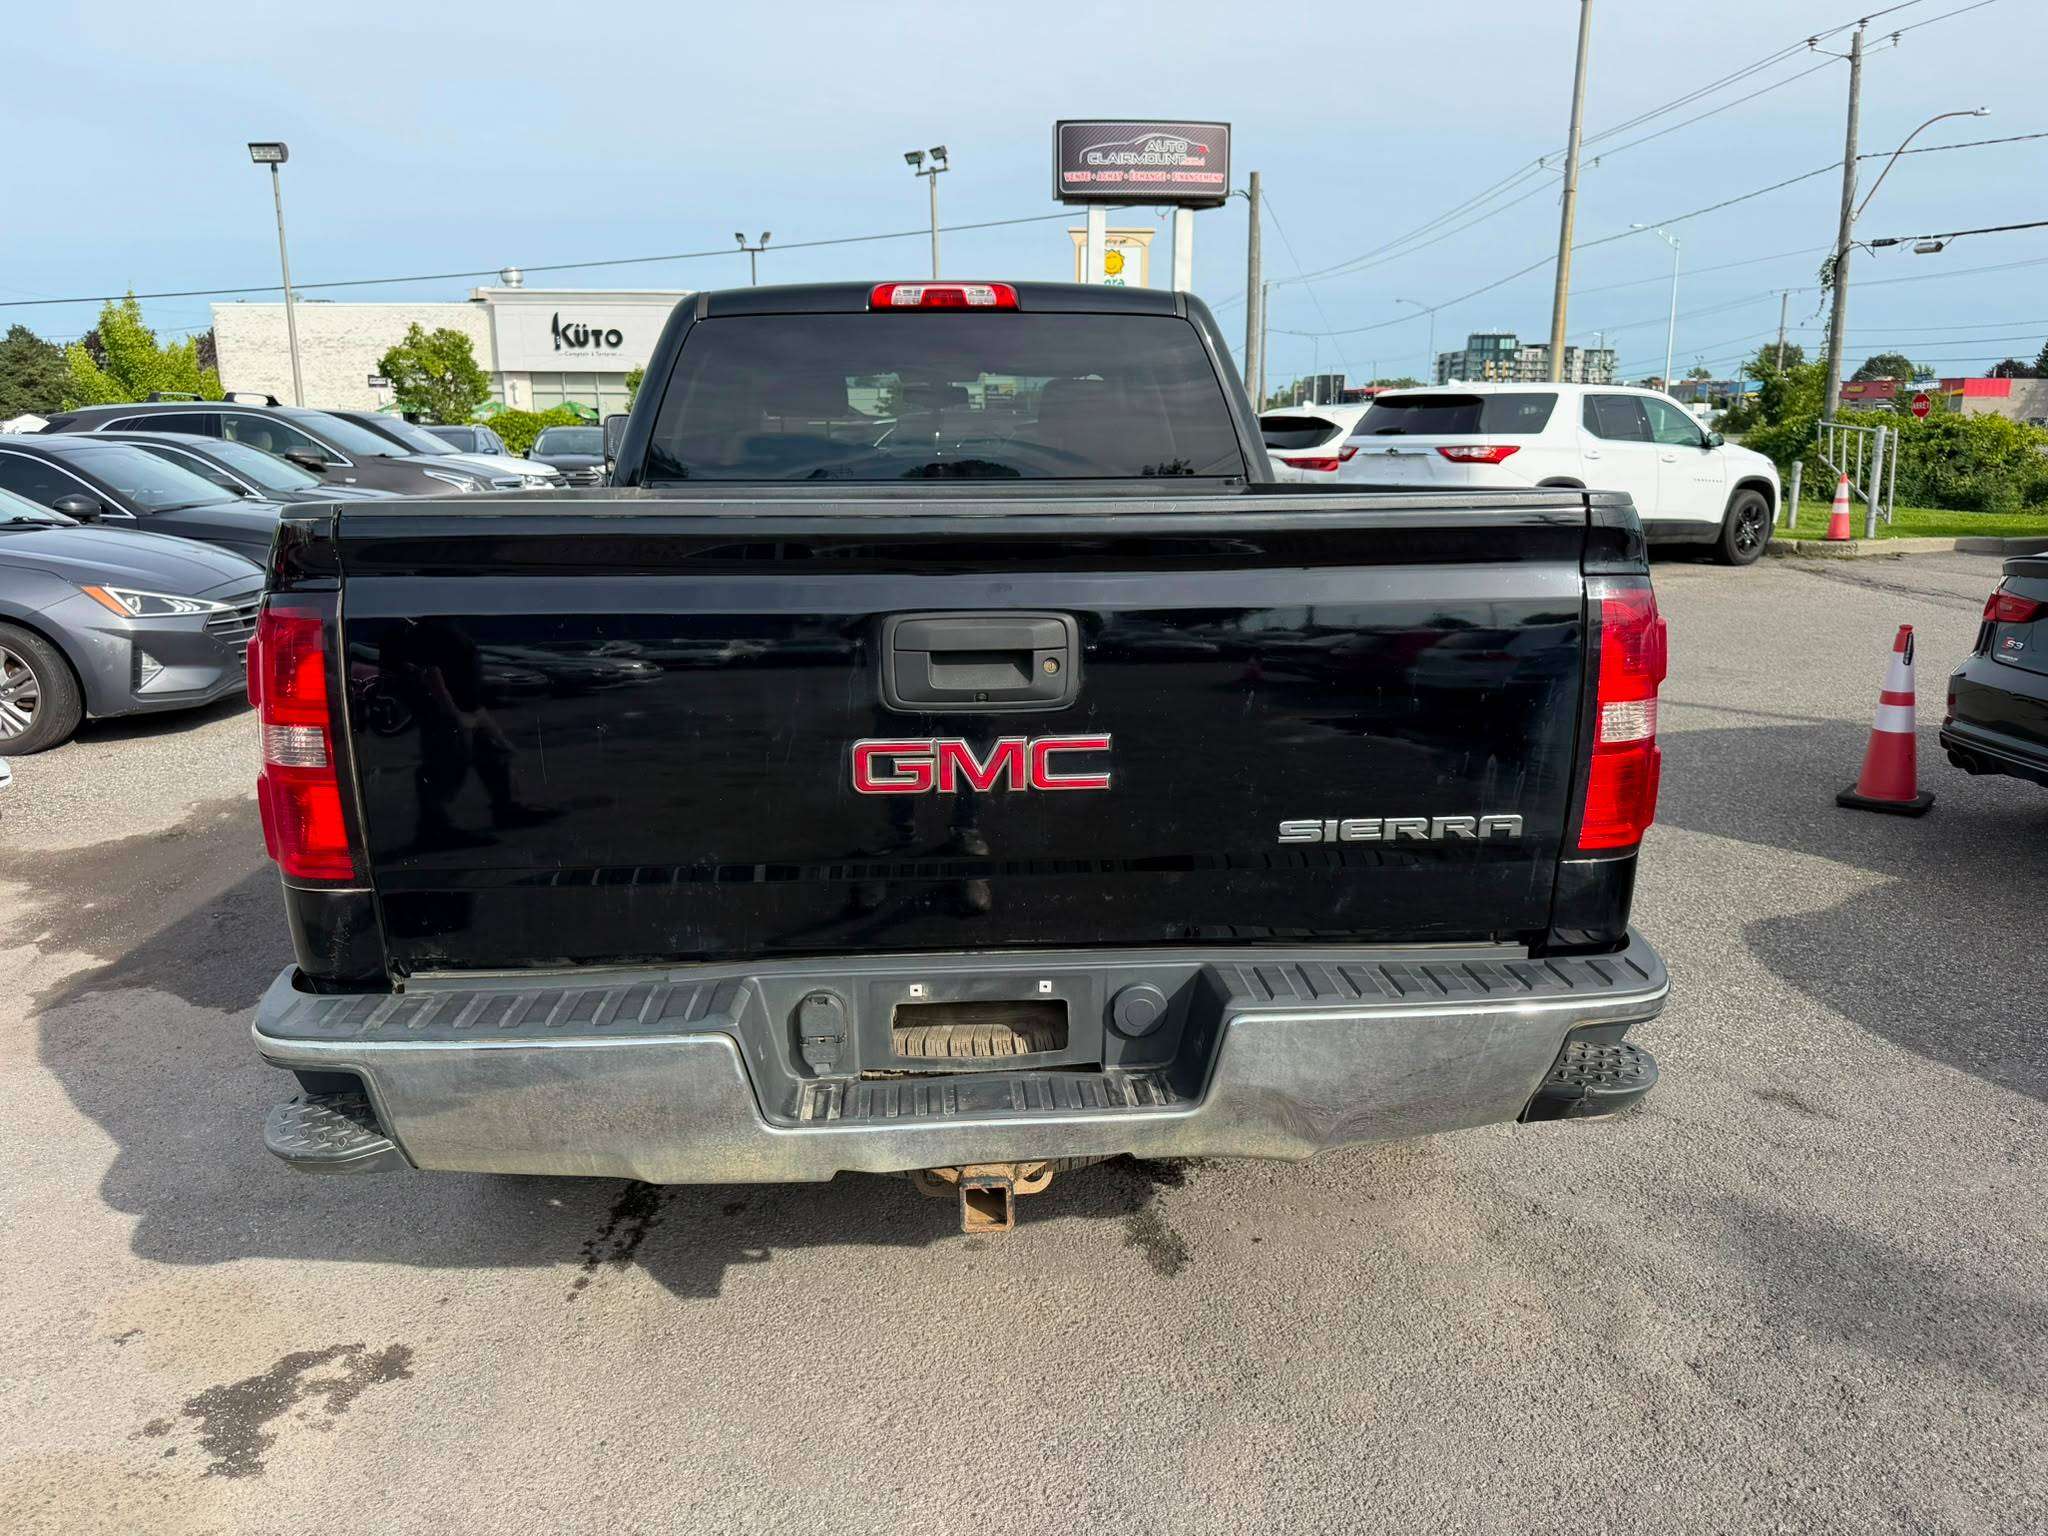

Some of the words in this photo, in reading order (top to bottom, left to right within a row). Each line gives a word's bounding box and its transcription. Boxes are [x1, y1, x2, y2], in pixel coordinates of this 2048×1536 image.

[1087, 152, 1187, 165] CLAIRMOUNT
[1145, 140, 1187, 152] AUTO
[551, 312, 624, 351] KÜTO
[852, 733, 1112, 795] GMC
[1277, 814, 1524, 844] SIERRA
